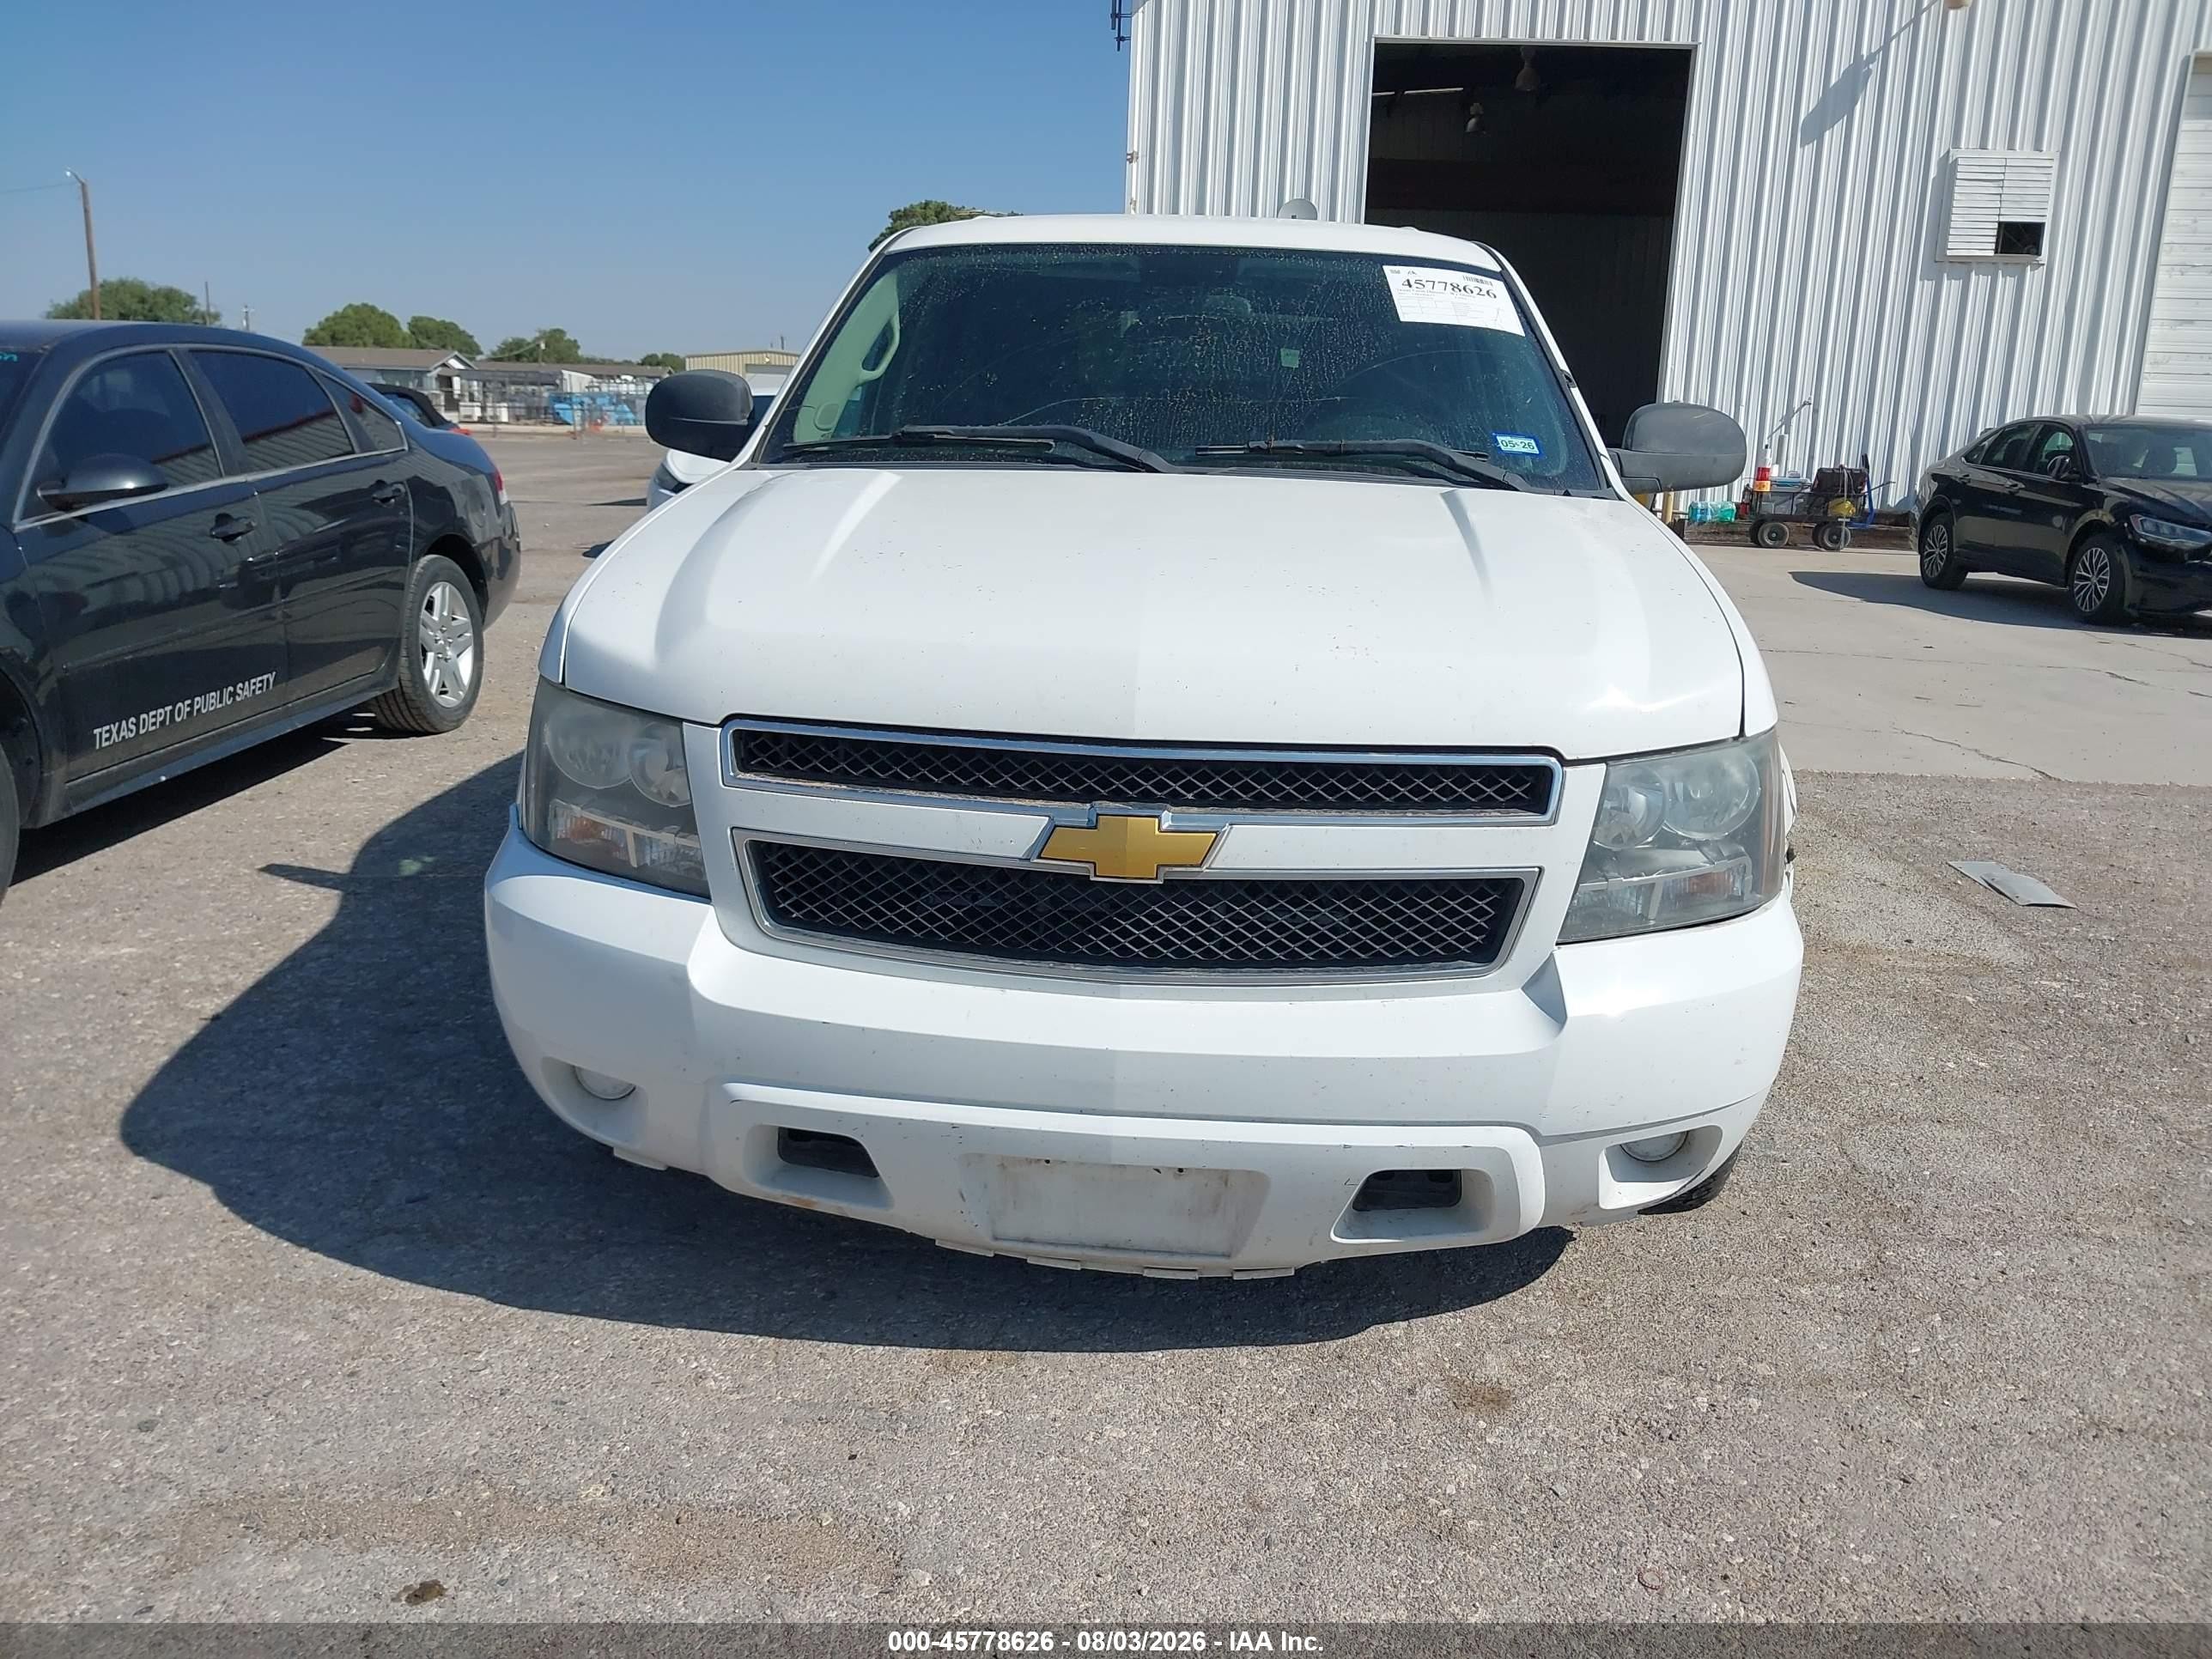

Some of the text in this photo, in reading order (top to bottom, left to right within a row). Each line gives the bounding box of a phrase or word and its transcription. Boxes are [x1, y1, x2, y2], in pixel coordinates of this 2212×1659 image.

[1401, 278, 1497, 299] 45778626
[93, 672, 276, 749] TEXAS DEPT OF PUBLIC SAFETY
